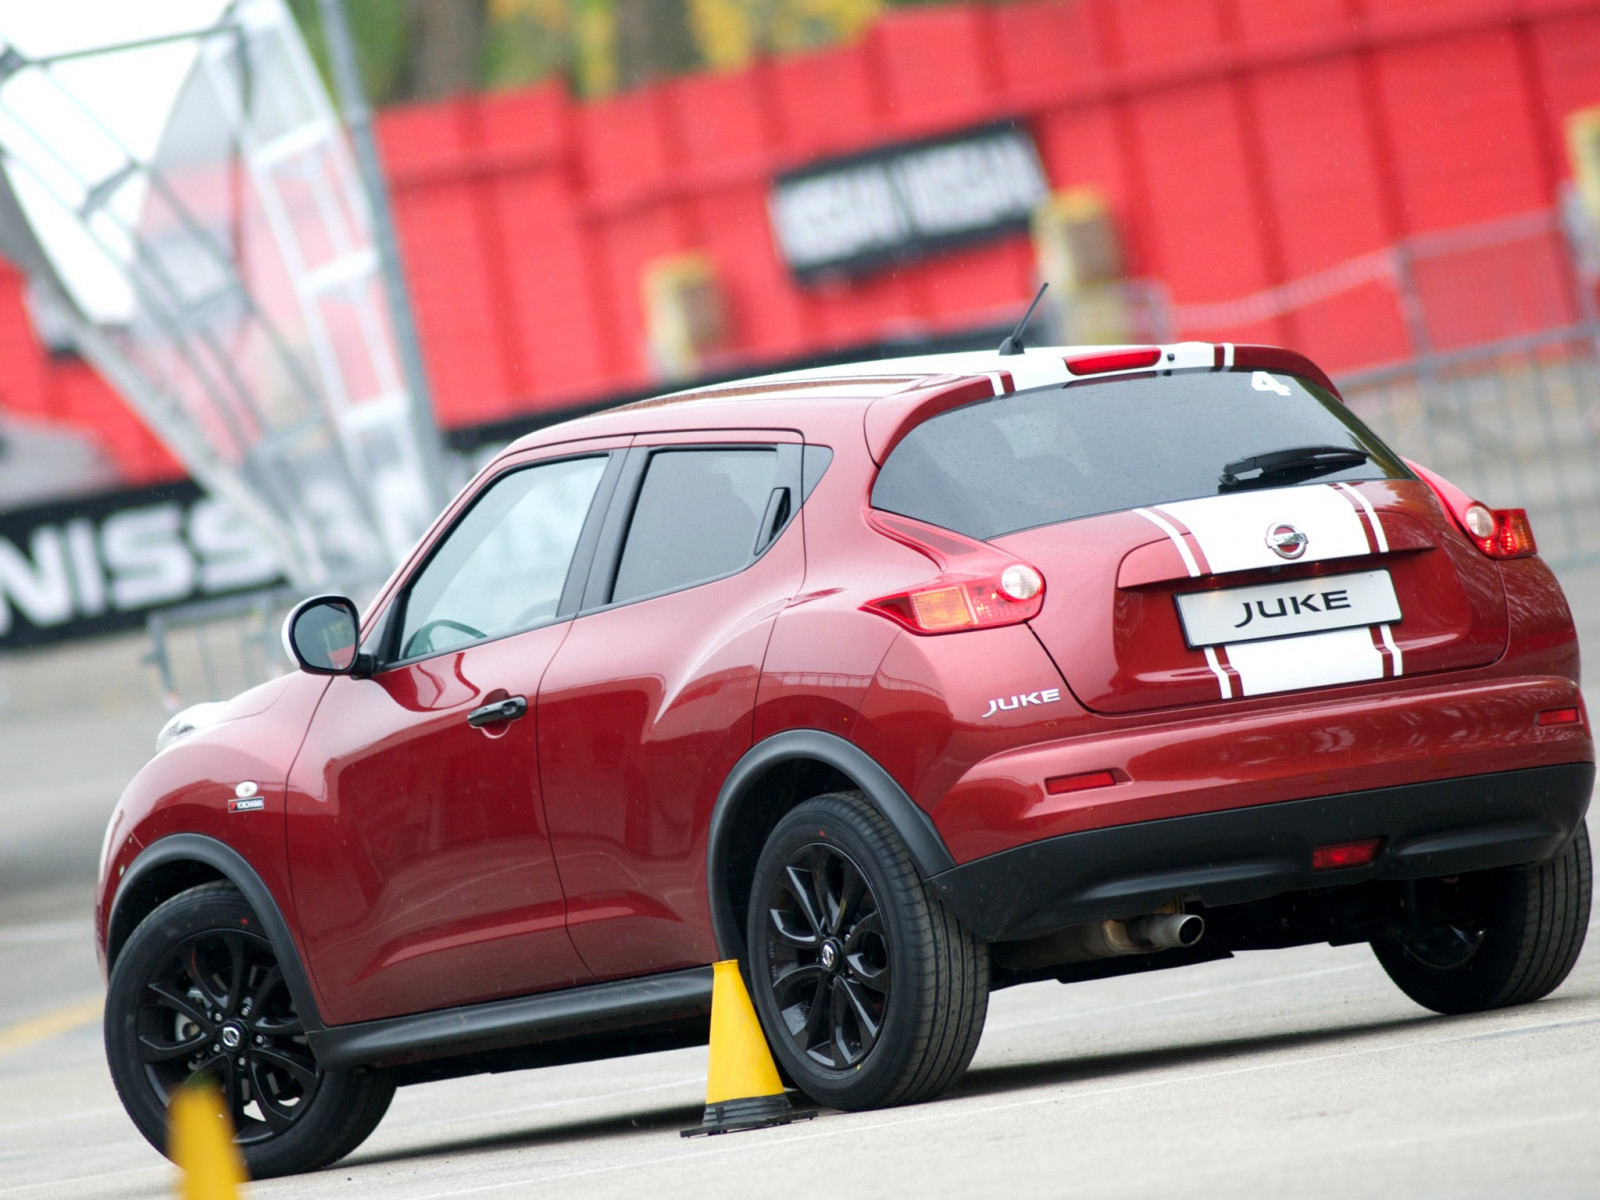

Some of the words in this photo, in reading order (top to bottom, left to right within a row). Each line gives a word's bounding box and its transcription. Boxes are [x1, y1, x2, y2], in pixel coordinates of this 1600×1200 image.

[1251, 371, 1292, 396] 4
[1233, 590, 1352, 628] JUKE
[981, 688, 1061, 718] JUKE
